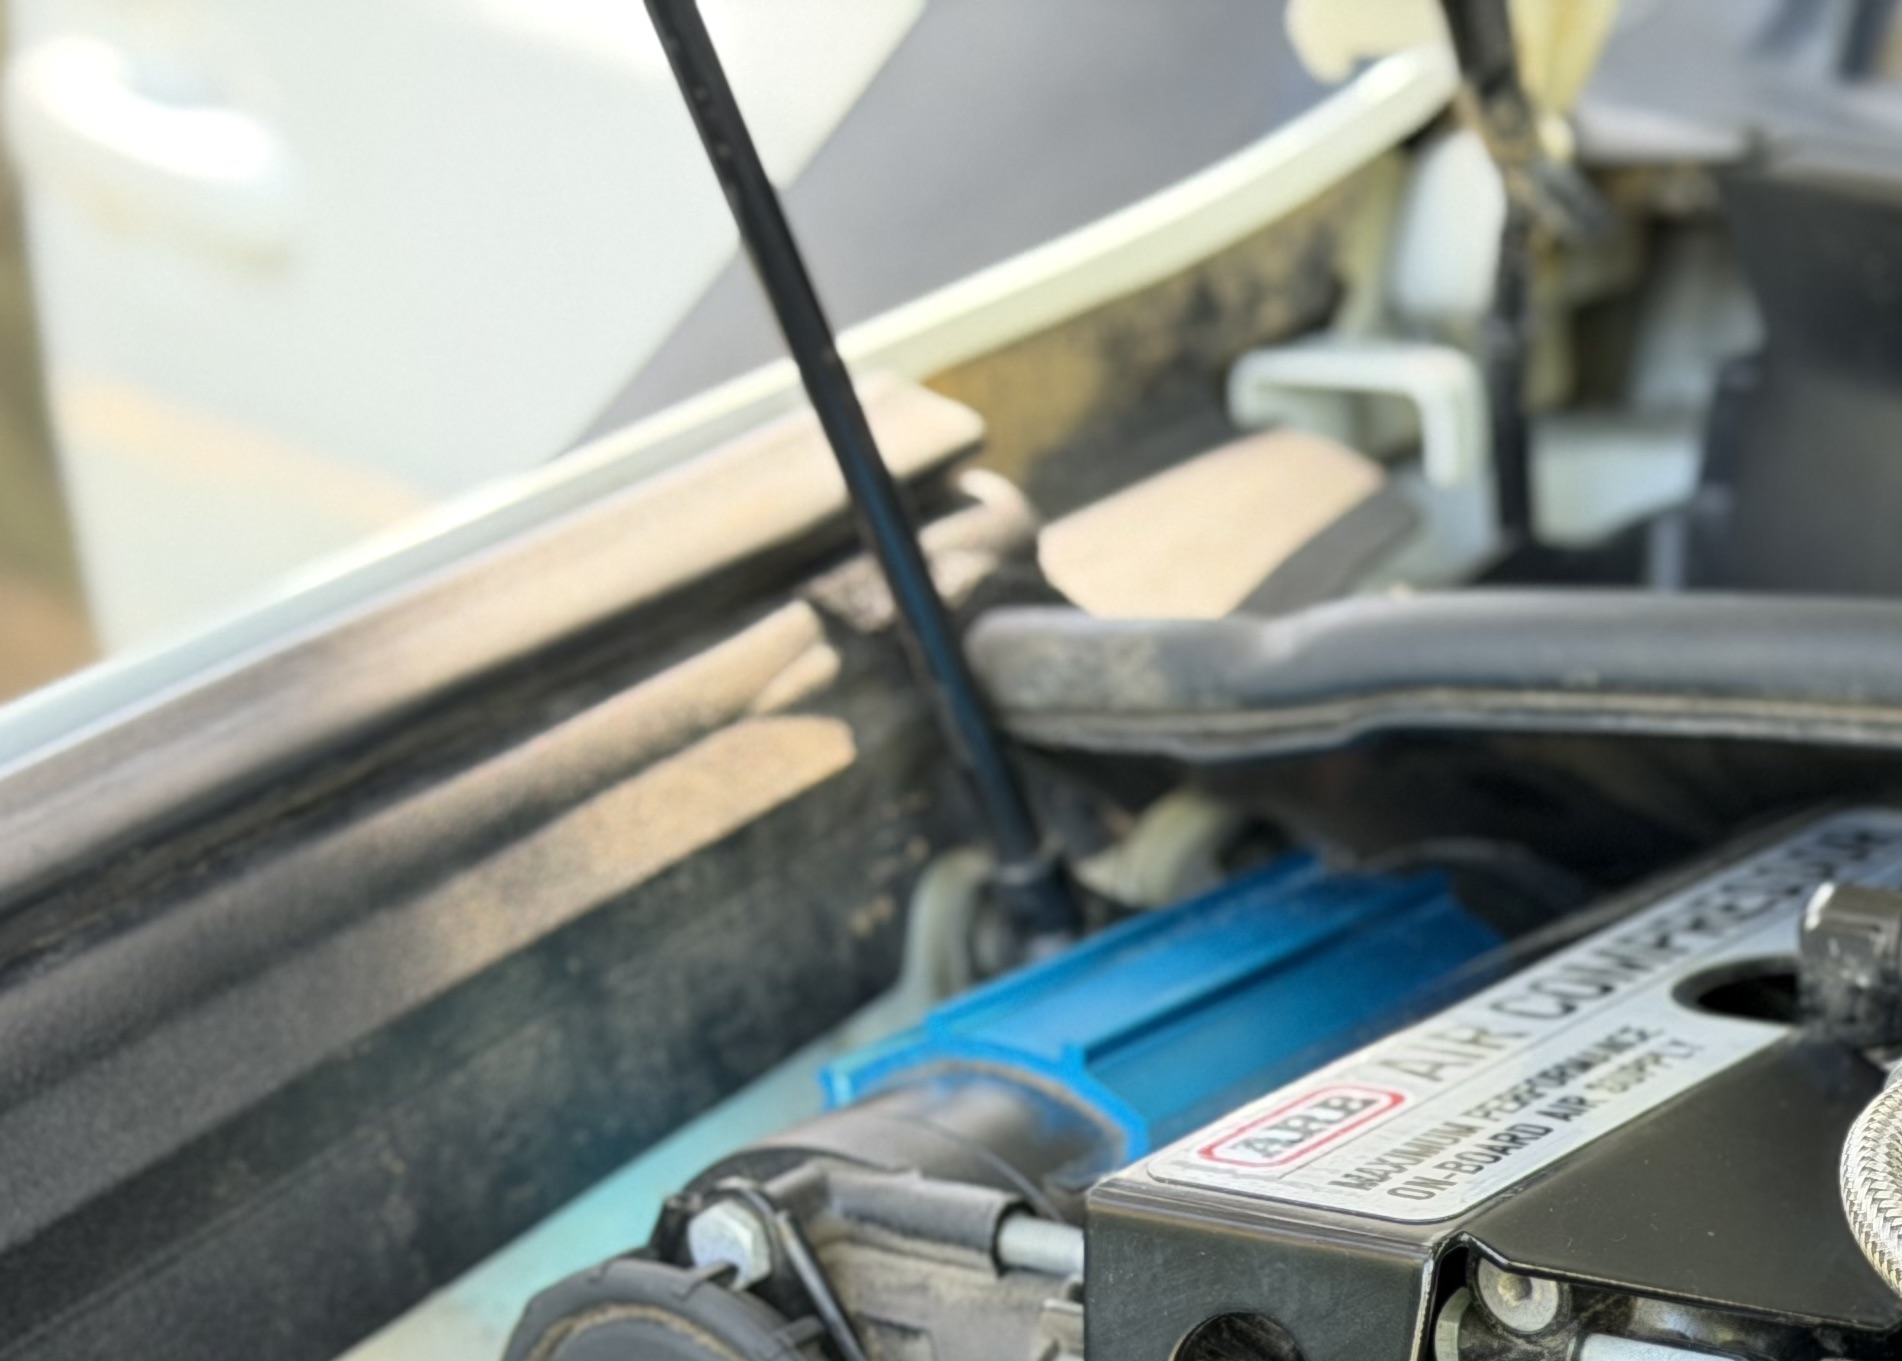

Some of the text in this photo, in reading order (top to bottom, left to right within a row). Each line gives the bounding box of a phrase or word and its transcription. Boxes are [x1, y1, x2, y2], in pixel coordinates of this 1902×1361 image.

[1230, 1095, 1378, 1159] ARB
[1376, 1022, 1530, 1082] AIR
[1328, 1024, 1664, 1192] MAXIMUM PERFORMANCE
[1386, 1040, 1706, 1201] ON-BOARD AIR SUPPLY
